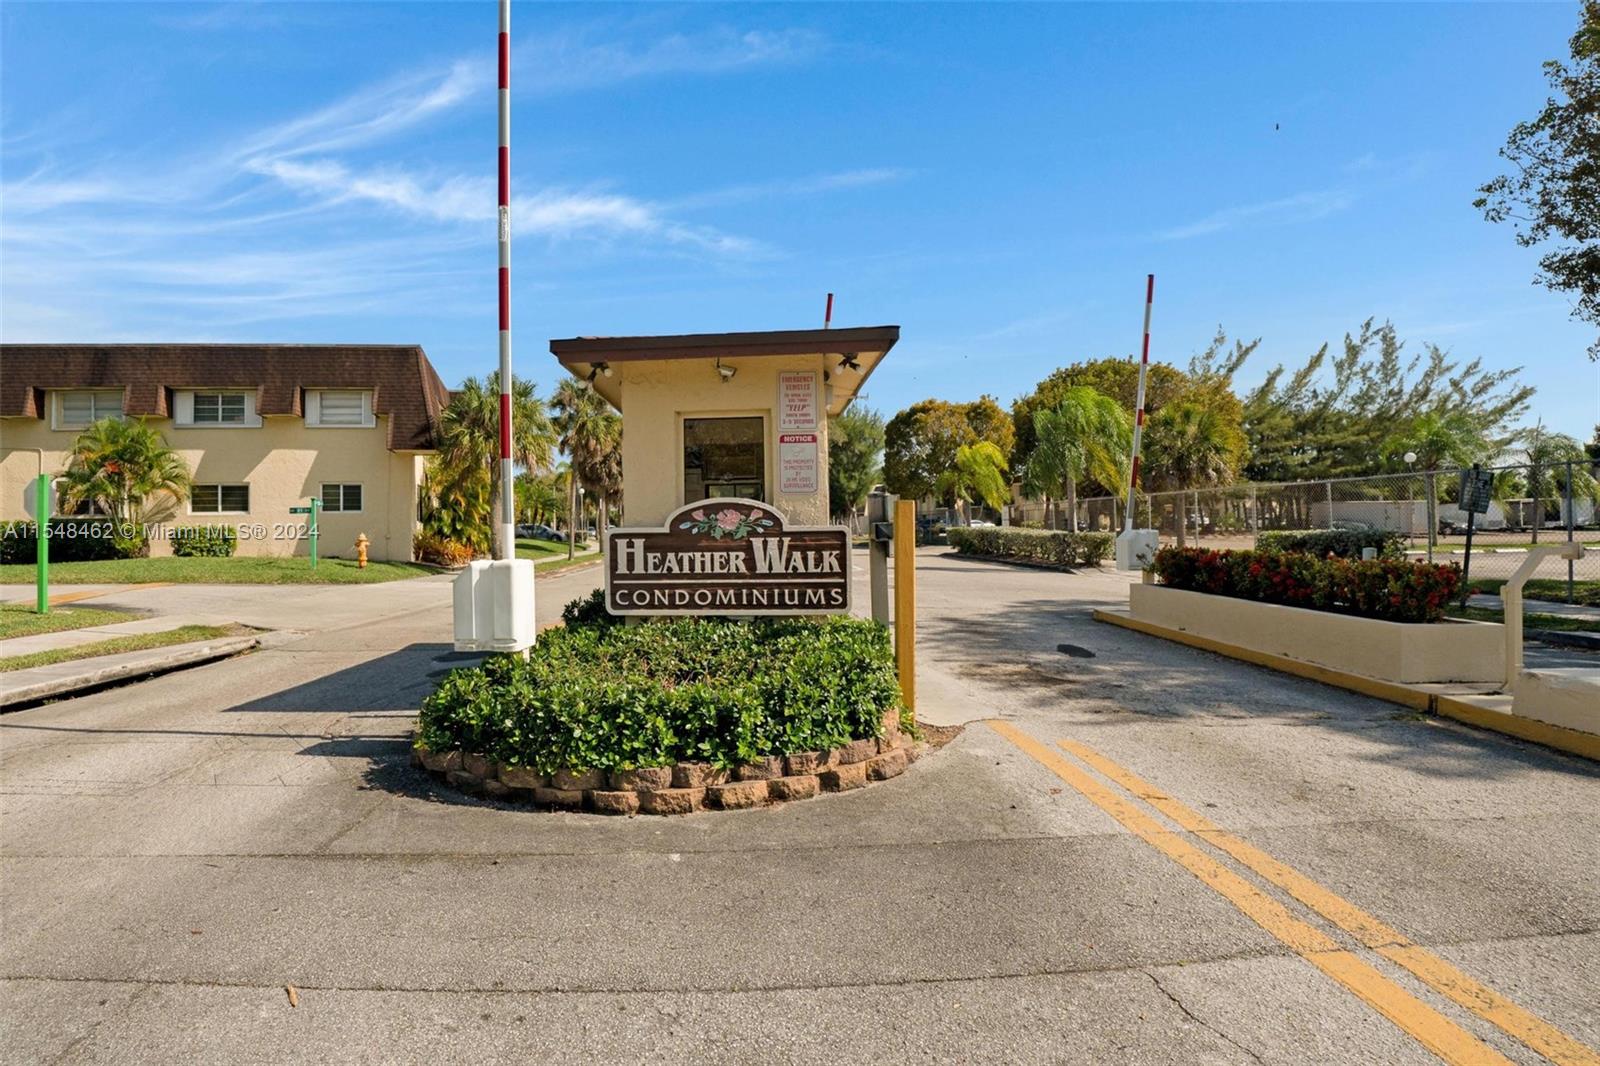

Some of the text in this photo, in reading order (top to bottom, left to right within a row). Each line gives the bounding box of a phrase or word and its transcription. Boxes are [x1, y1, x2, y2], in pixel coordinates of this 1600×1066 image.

[782, 375, 813, 383] EMERGENCY
[784, 435, 813, 443] NOTICE
[615, 537, 842, 574] HEATHER WALK
[615, 588, 843, 606] CONDOMINIUMS
